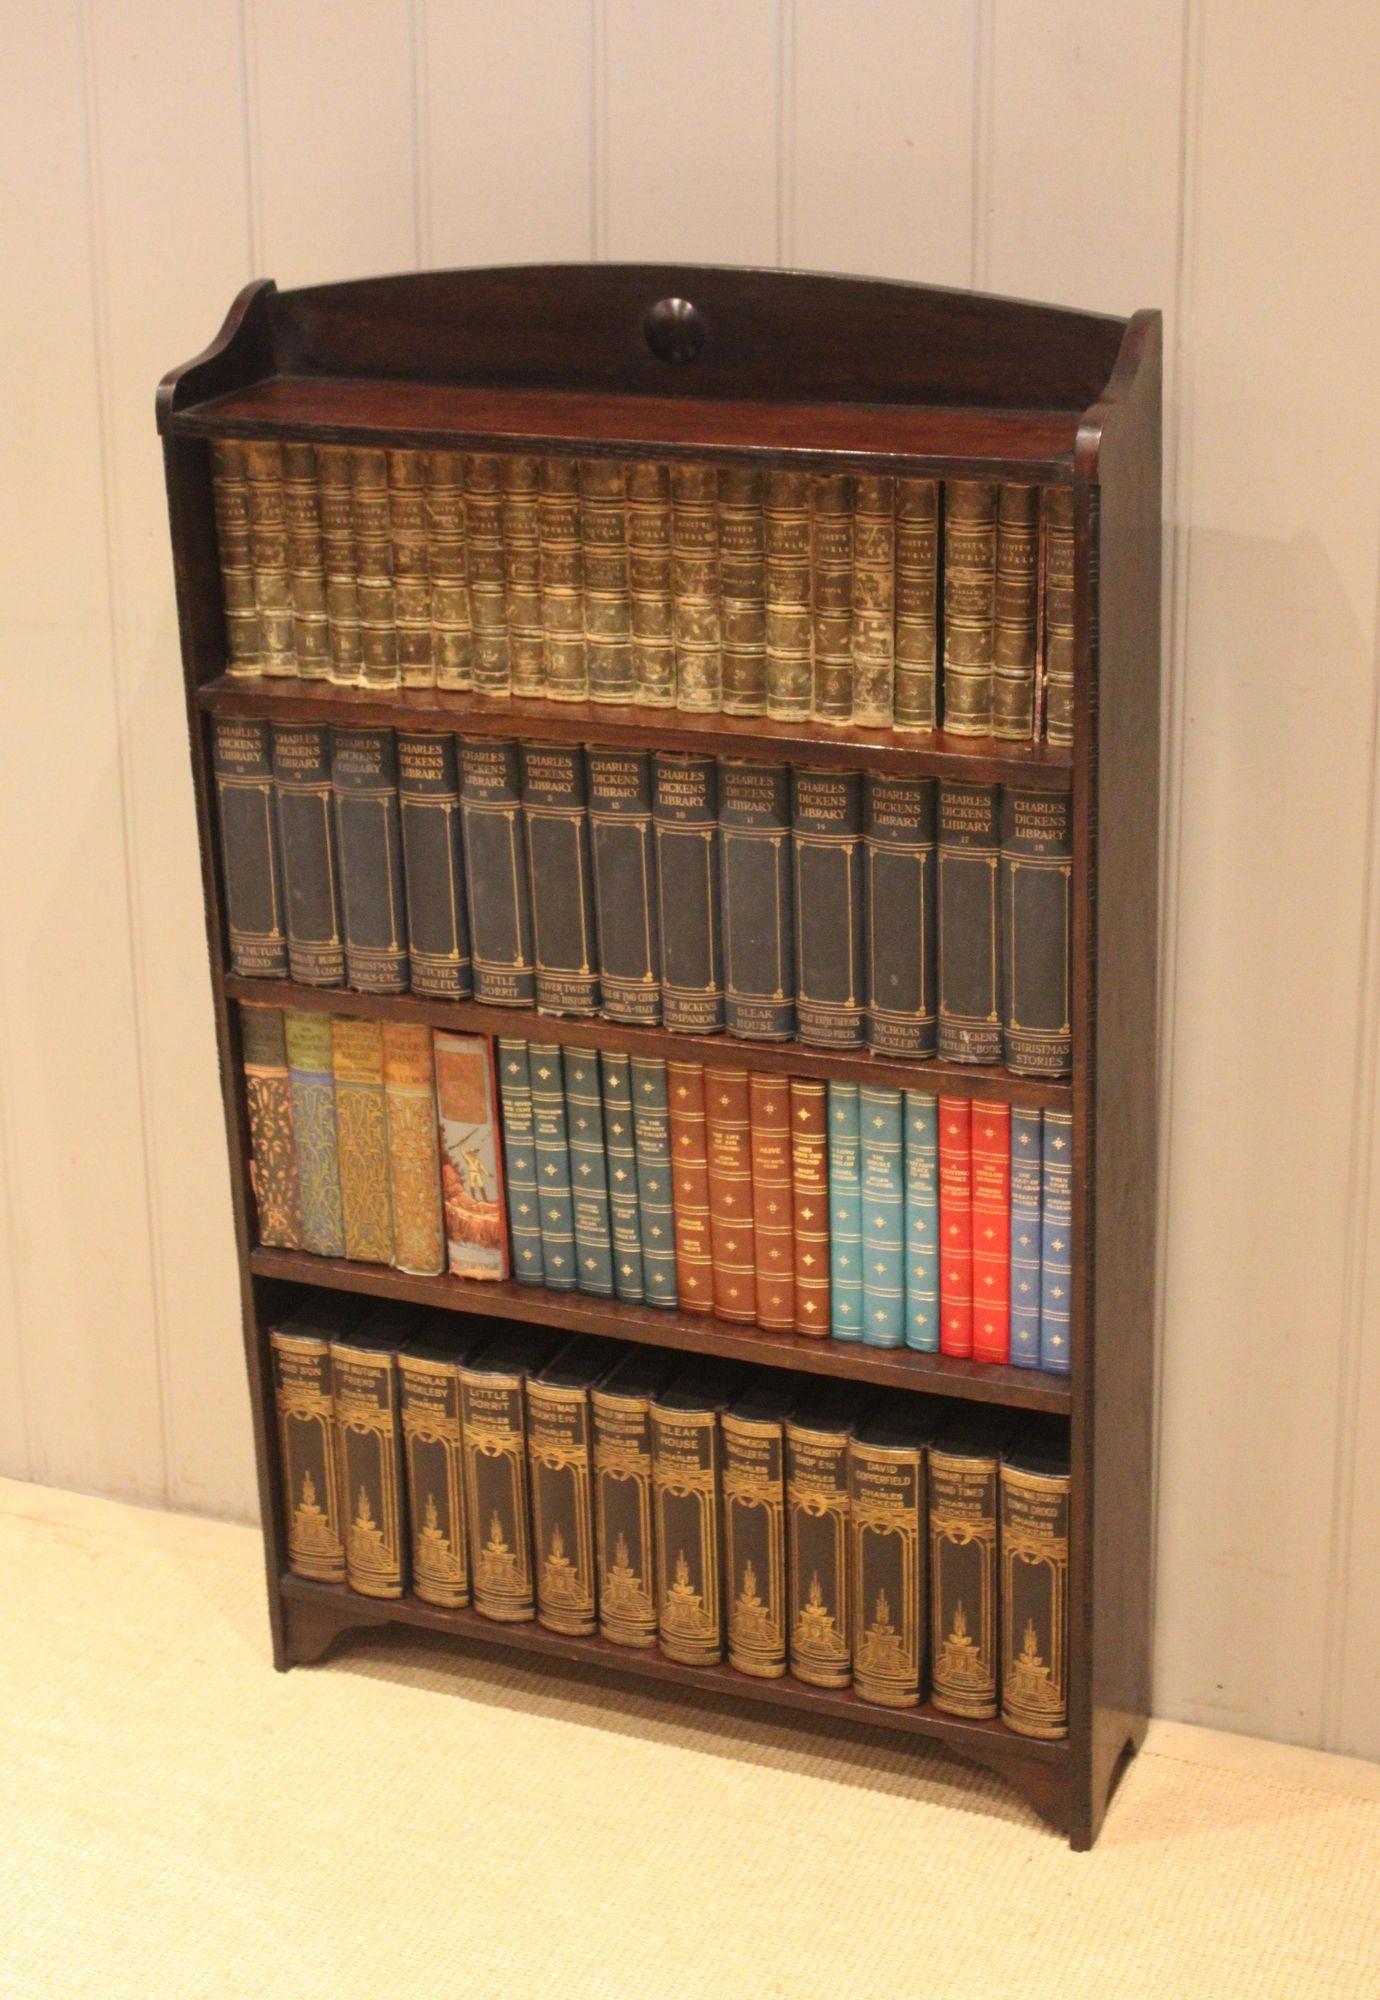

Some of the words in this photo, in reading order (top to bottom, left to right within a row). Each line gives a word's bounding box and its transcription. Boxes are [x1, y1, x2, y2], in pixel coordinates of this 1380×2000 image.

[216, 728, 260, 738] CHARLES
[218, 739, 261, 749] DICKENS
[274, 734, 320, 745] CHARLES
[277, 746, 320, 756] DICKENS
[399, 744, 443, 754] CHARLES
[219, 751, 262, 762] LIBRARY
[337, 750, 382, 761] DICKENS
[401, 755, 444, 766] DICKENS
[463, 750, 505, 761] CHARLES
[526, 755, 572, 767] CHARLES
[278, 757, 321, 768] LIBRARY
[338, 762, 382, 773] LIBRARY
[464, 762, 506, 774] DICKENS
[591, 761, 638, 772] CHARLES
[402, 768, 444, 779] LIBRARY
[528, 768, 573, 779] DICKENS
[593, 773, 638, 784] DICKENS
[657, 768, 704, 780] CHARLES
[465, 775, 506, 787] LIBRARY
[529, 780, 573, 792] LIBRARY
[725, 774, 774, 786] CHARLES
[594, 786, 639, 797] LIBRARY
[659, 781, 705, 794] DICKENS
[727, 787, 774, 799] DICKENS
[798, 781, 846, 794] CHARLES
[660, 794, 706, 806] LIBRARY
[800, 794, 846, 806] DICKENS
[873, 788, 920, 801] CHARLES
[941, 793, 991, 807] CHARLES
[727, 800, 774, 812] LIBRARY
[873, 800, 920, 814] DICKENS
[1014, 801, 1065, 813] CHARLES
[800, 807, 847, 819] LIBRARY
[943, 806, 991, 820] DICKENS
[874, 813, 920, 827] LIBRARY
[943, 819, 992, 832] LIBRARY
[1016, 813, 1065, 827] DICKENS
[1016, 826, 1065, 840] LIBRARY
[482, 974, 516, 986] LITTLE
[481, 987, 519, 997] DORRIT
[680, 1001, 717, 1013] DICKENS
[737, 1007, 774, 1019] BLEAK
[666, 1011, 716, 1024] COMPANION
[737, 1019, 774, 1031] HOUSE
[874, 1023, 919, 1037] NICHOLAS
[875, 1034, 919, 1048] NICKLEBY
[958, 1030, 996, 1042] DICKENS
[1011, 1041, 1068, 1055] CHRISTMAS
[1015, 1055, 1062, 1066] STORIES
[300, 1366, 321, 1376] SON
[470, 1389, 508, 1400] LITTLE
[470, 1398, 509, 1410] DORRIT
[529, 1396, 576, 1413] CHRISTMAS
[659, 1424, 698, 1437] BLEAK
[659, 1436, 698, 1449] HOUSE
[867, 1462, 898, 1474] DAVID
[795, 1471, 836, 1483] CHARLES
[856, 1472, 911, 1486] COPPERFIELD
[860, 1488, 903, 1500] CHARLES
[938, 1498, 981, 1510] CHARLES
[1010, 1514, 1053, 1529] CHARLES
